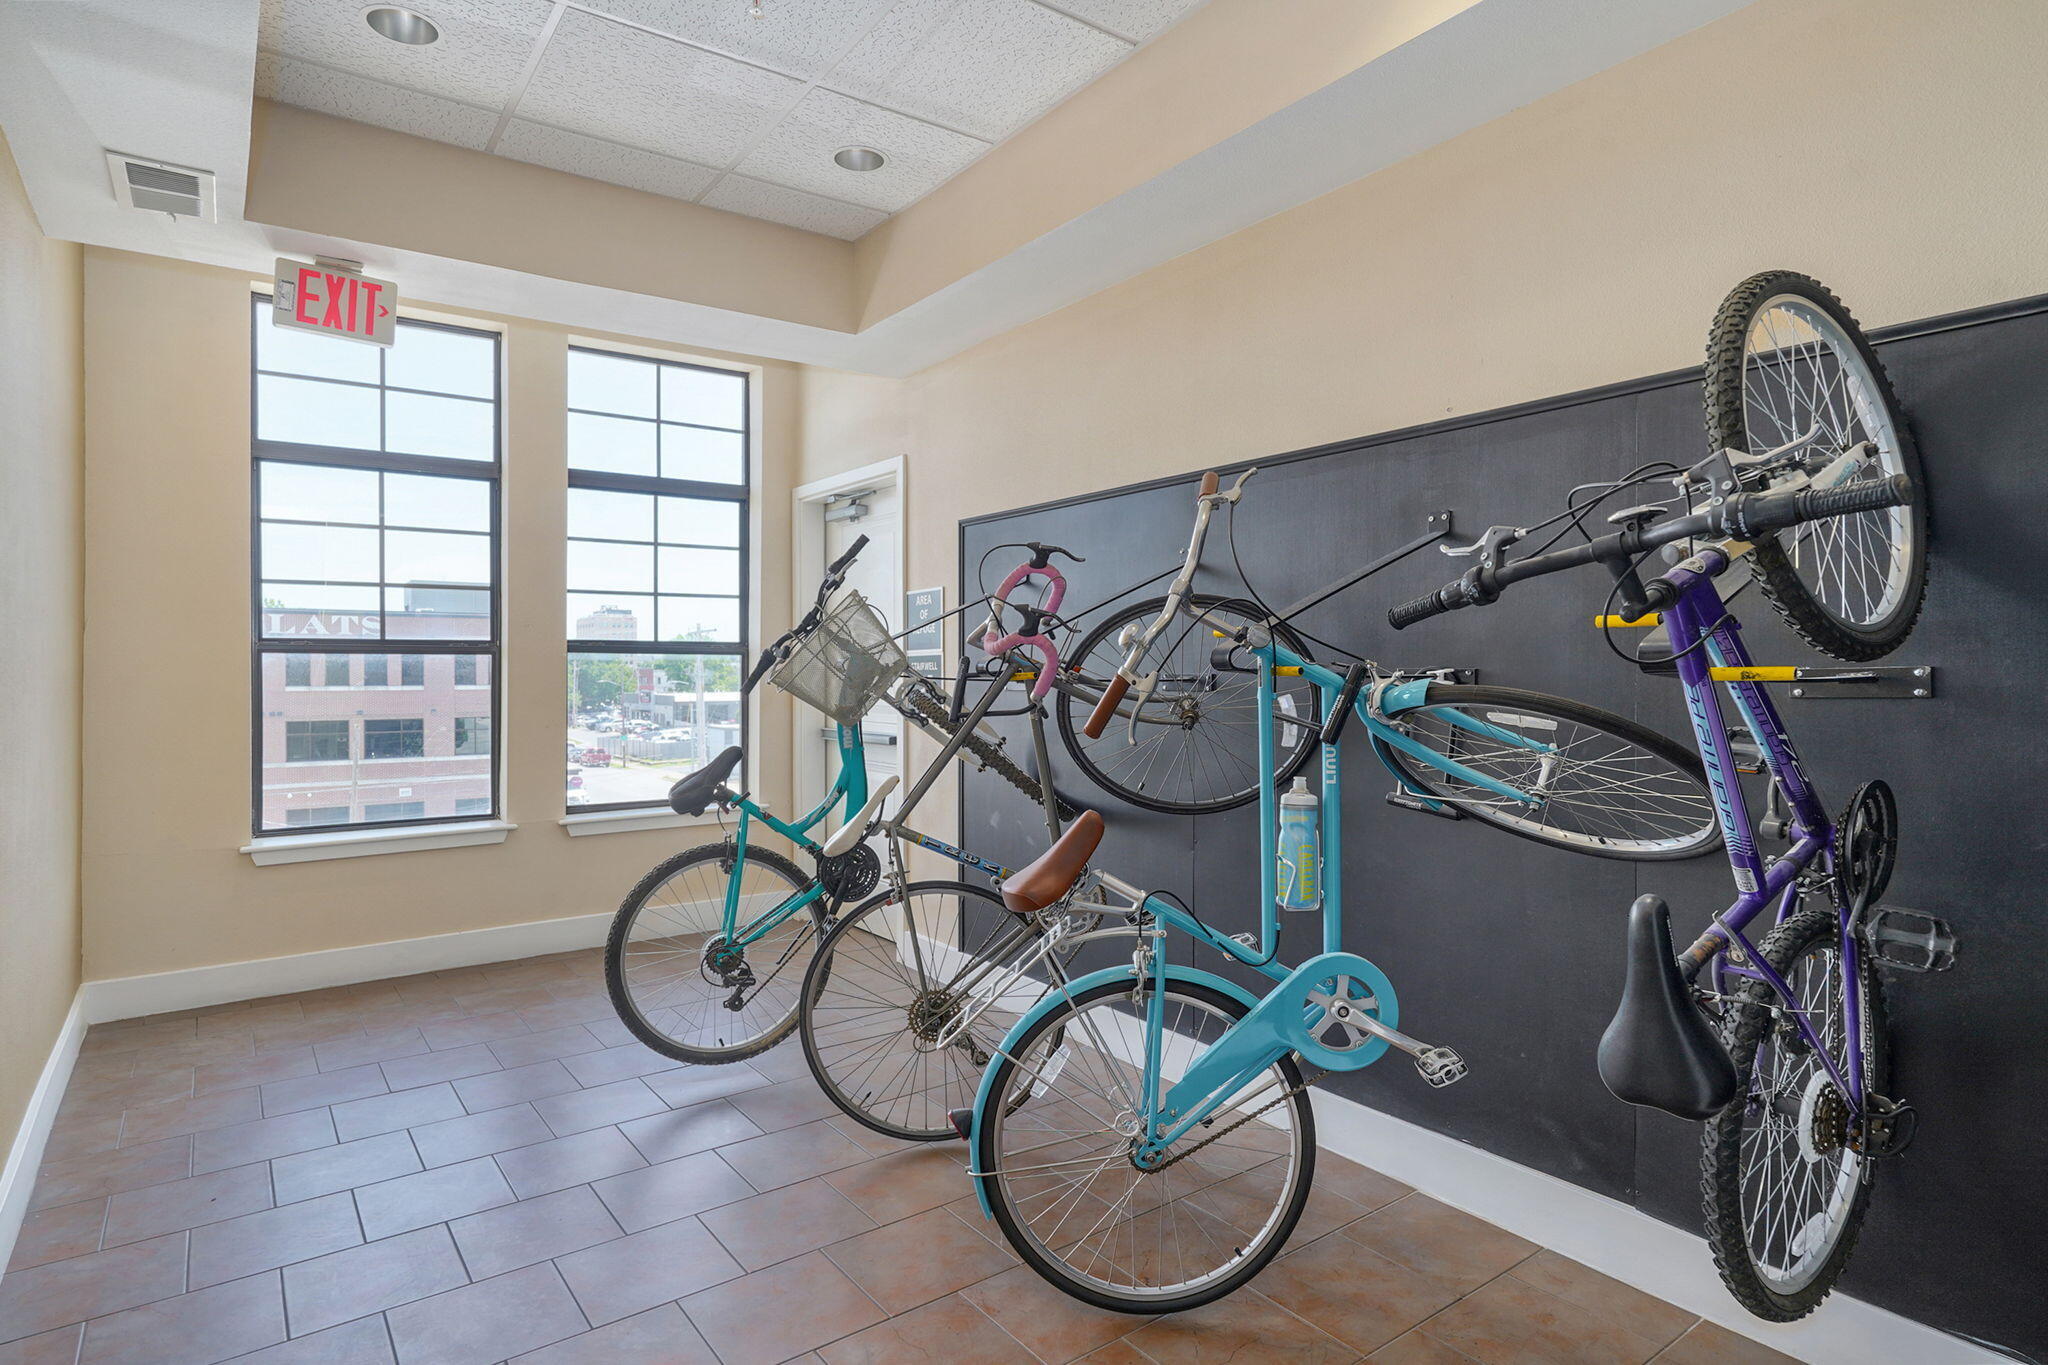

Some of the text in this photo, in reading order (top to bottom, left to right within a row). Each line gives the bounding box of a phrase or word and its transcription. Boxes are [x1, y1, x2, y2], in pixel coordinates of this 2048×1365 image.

[296, 268, 382, 336] EXIT
[915, 594, 932, 606] AREA
[919, 608, 928, 620] OF
[1325, 744, 1337, 785] LINU
[924, 837, 1001, 874] TREK
